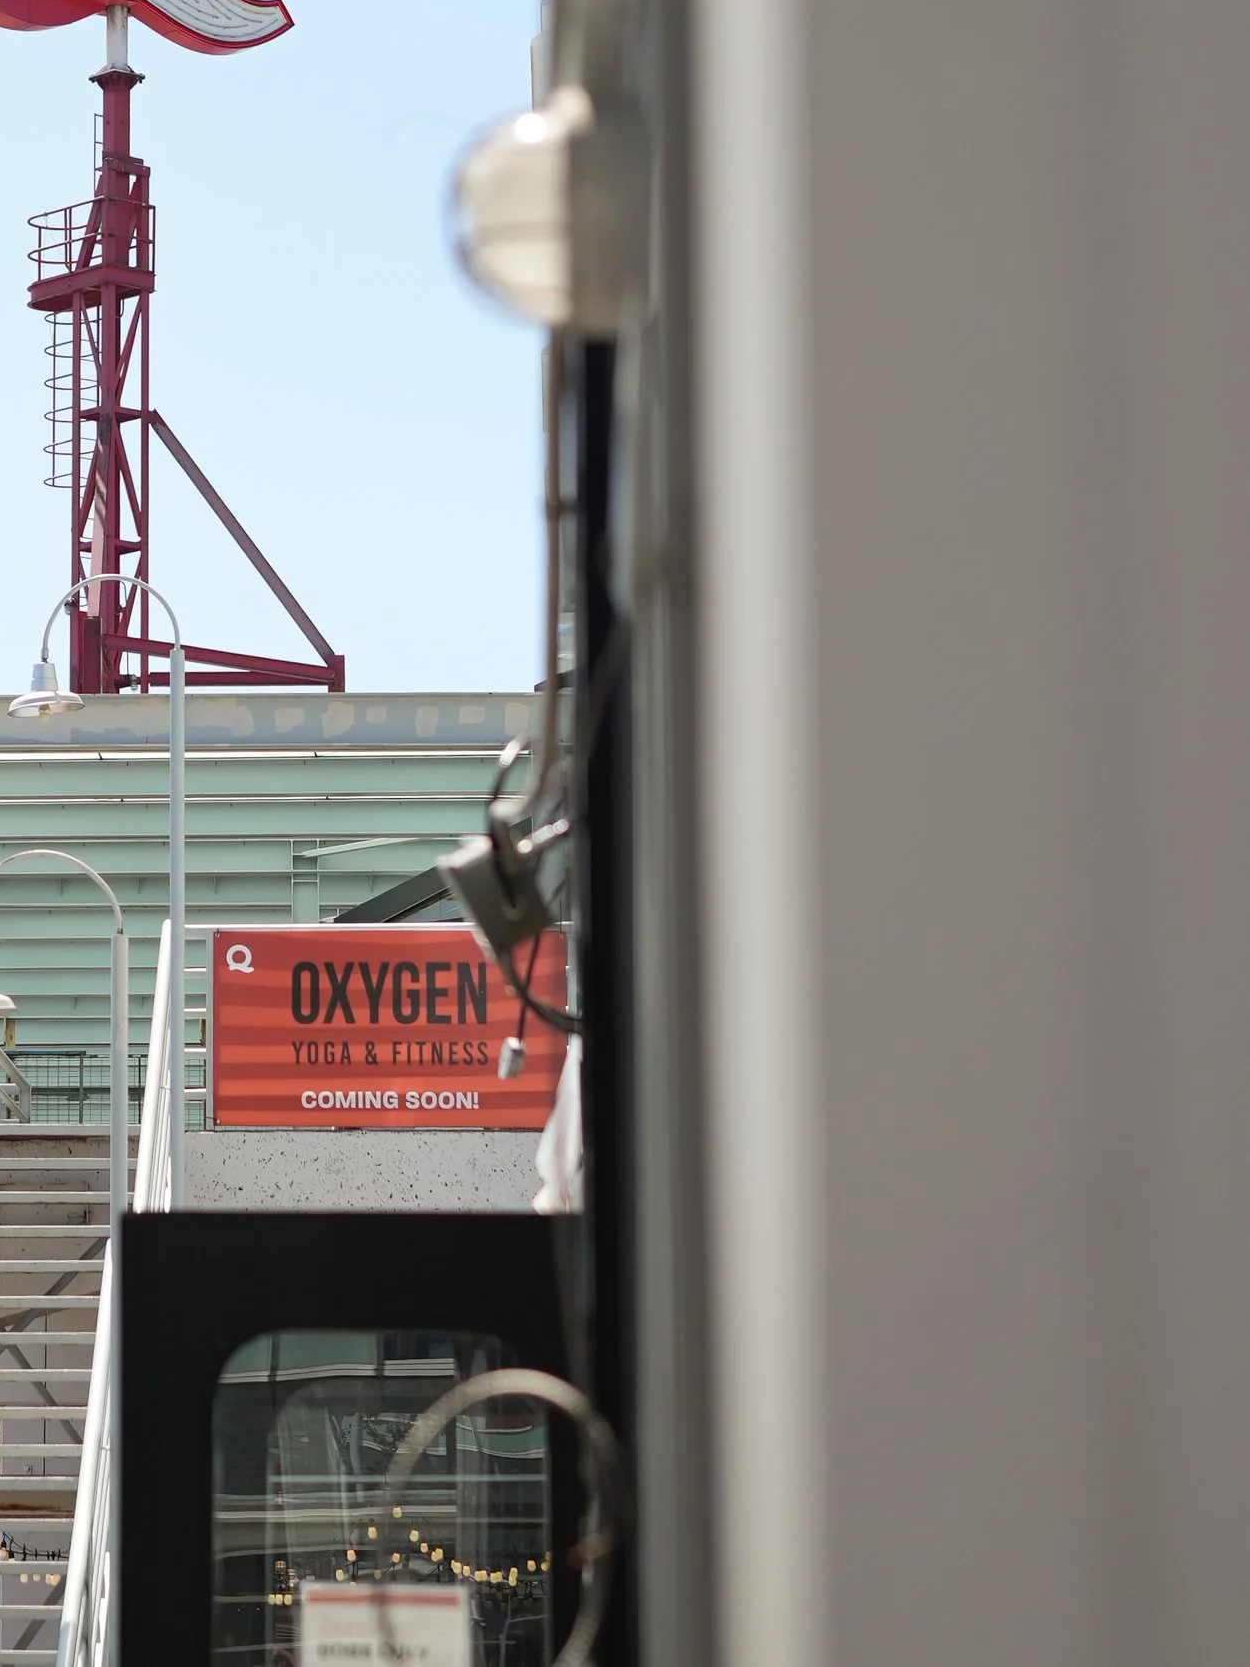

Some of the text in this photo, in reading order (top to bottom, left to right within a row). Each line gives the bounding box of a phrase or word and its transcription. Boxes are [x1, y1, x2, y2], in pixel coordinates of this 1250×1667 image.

[225, 944, 255, 973] Q
[292, 961, 487, 1024] OXYGEN
[291, 1040, 489, 1066] YOGA & FITNESS
[300, 1090, 480, 1110] COMING SOON!
